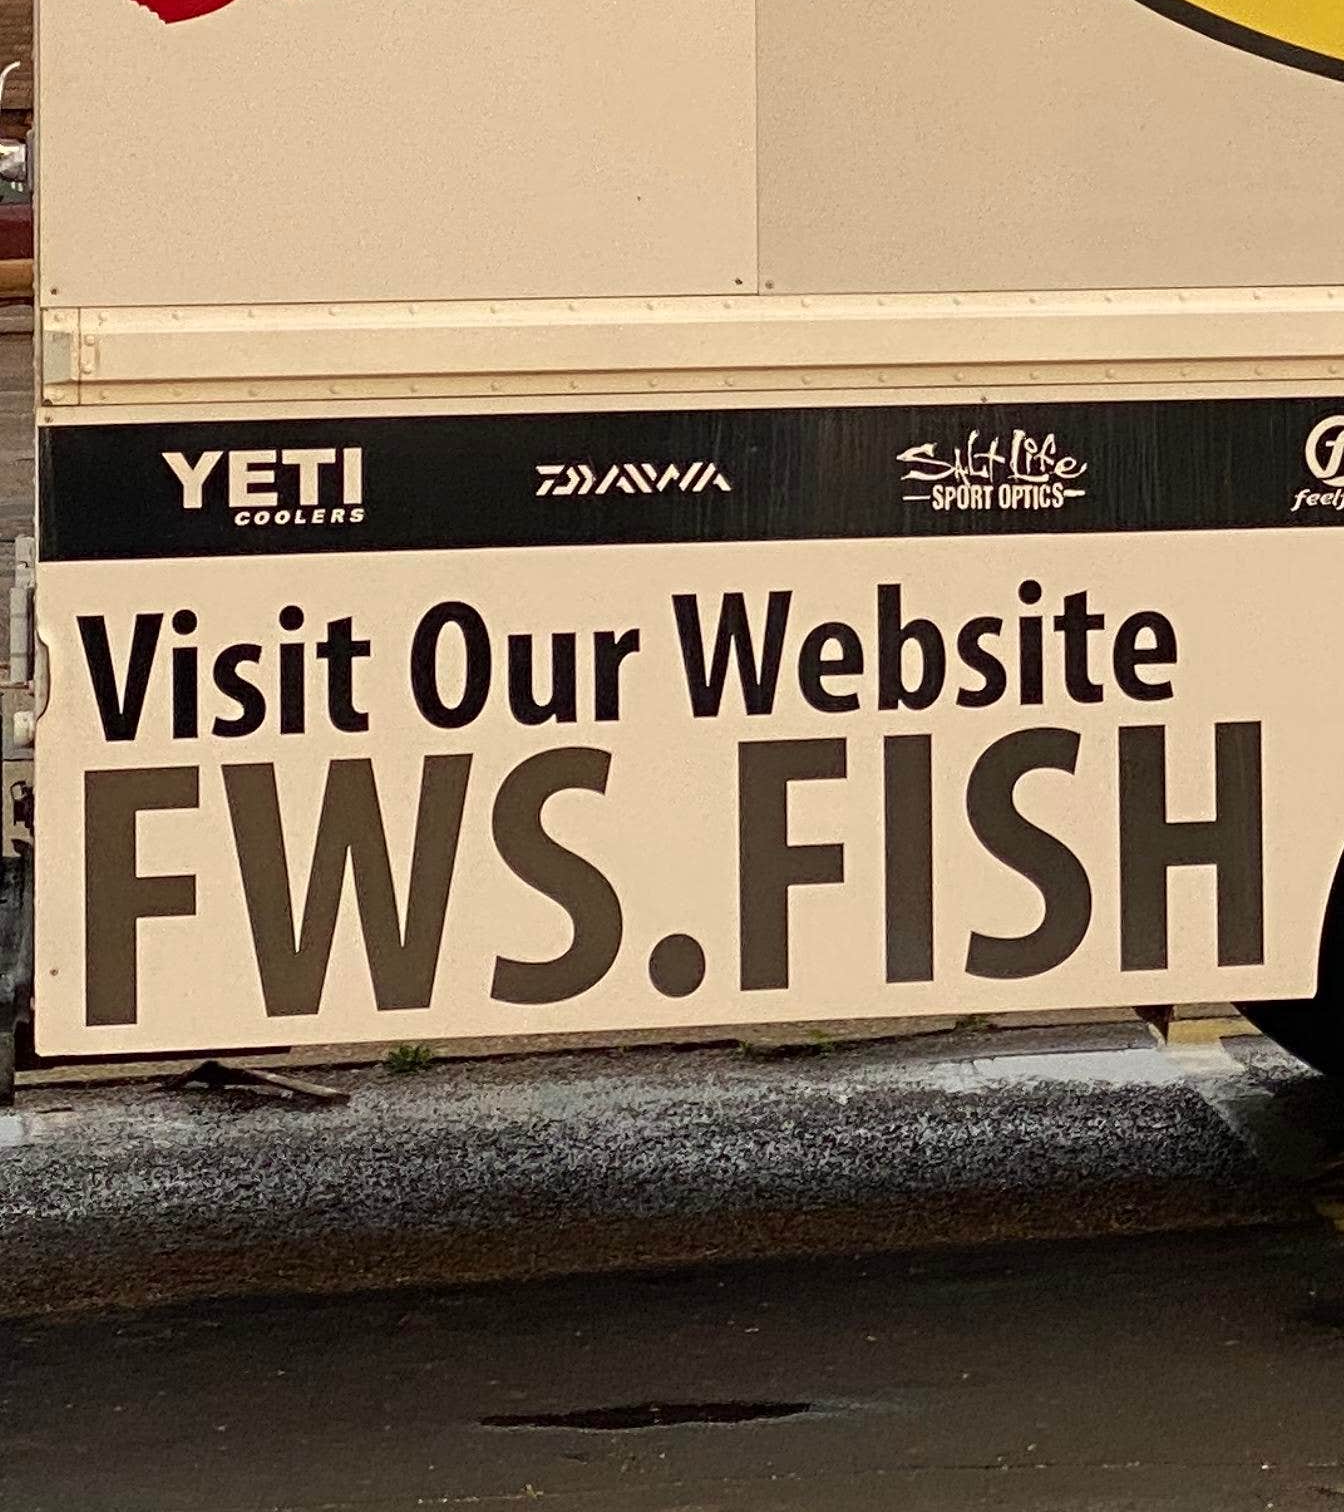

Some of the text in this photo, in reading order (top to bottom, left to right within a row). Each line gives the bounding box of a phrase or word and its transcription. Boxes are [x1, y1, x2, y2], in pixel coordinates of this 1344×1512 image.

[161, 447, 363, 509] YETI
[932, 482, 1064, 510] SPORT OPTICS
[234, 507, 366, 526] COOLERS
[76, 579, 1177, 742] Visit Our Website
[84, 720, 1264, 1028] FWS.FISH
